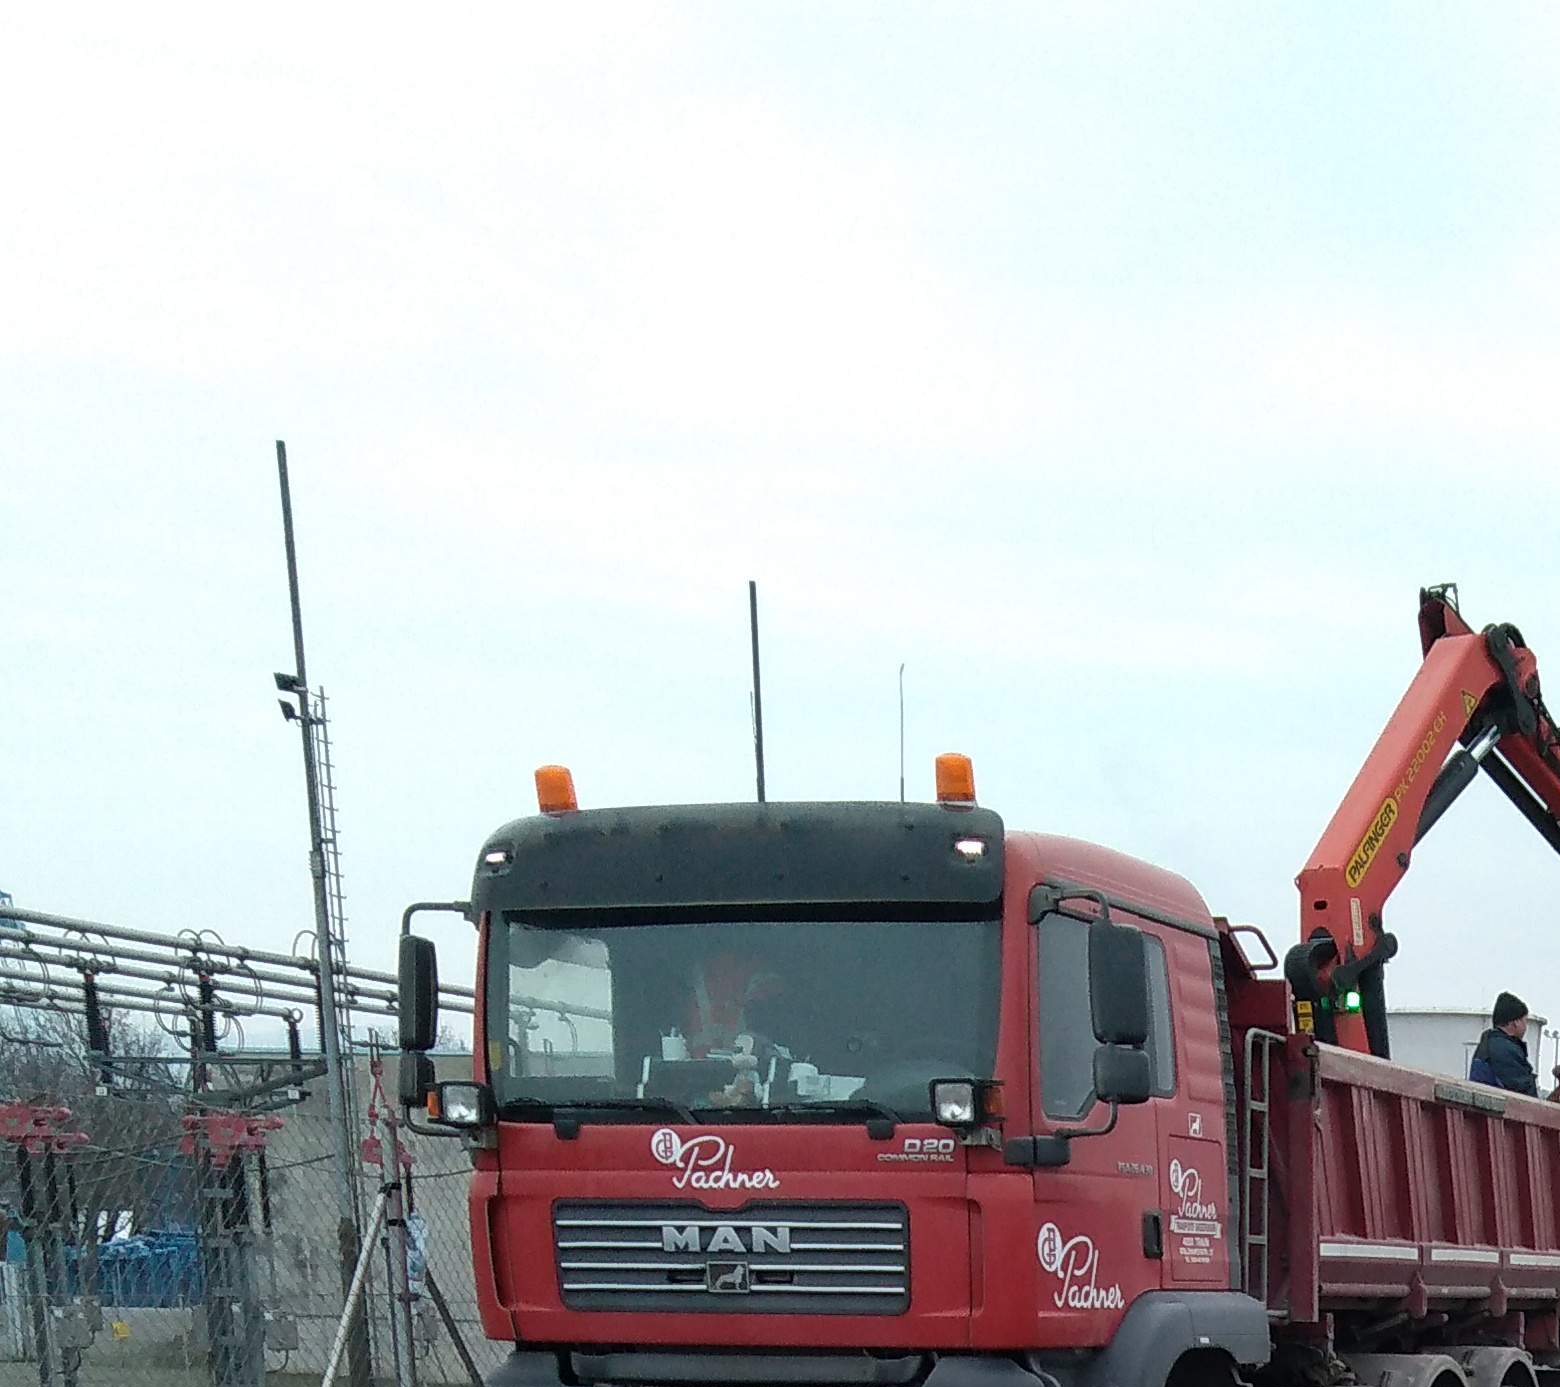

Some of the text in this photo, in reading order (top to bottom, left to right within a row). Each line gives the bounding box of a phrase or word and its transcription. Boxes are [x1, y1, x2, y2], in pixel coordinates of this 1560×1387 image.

[1349, 803, 1396, 883] PALFINGER
[672, 1135, 781, 1189] Pachner
[877, 1153, 928, 1162] COMMON
[662, 1226, 791, 1253] MAN
[1053, 1235, 1125, 1309] Pachner
